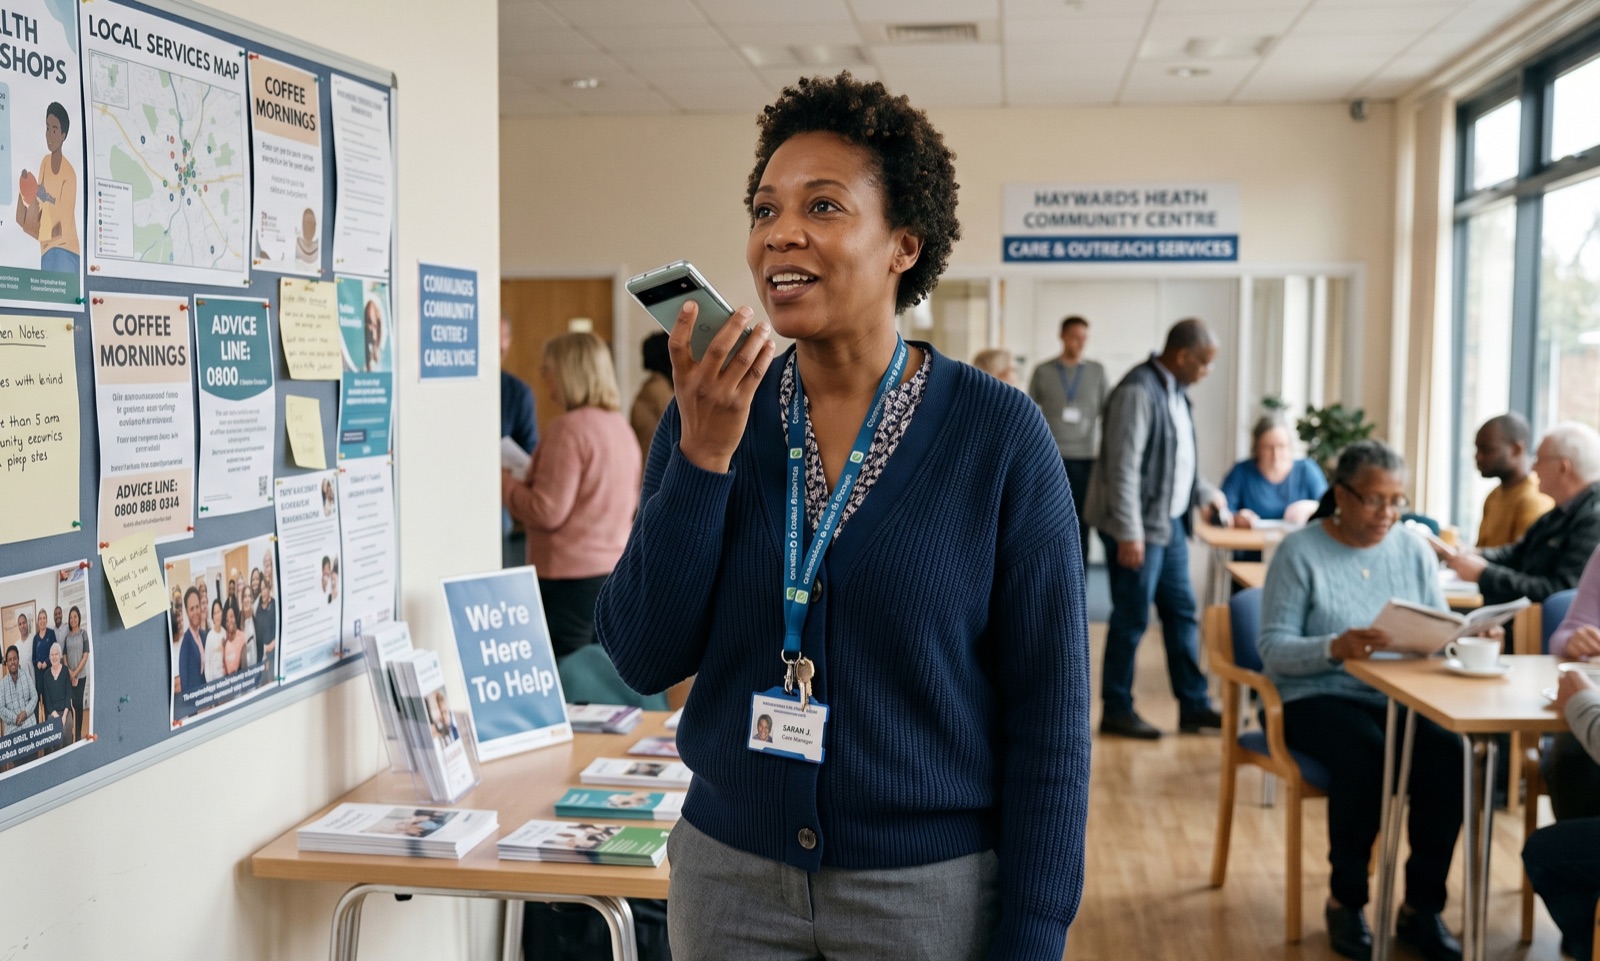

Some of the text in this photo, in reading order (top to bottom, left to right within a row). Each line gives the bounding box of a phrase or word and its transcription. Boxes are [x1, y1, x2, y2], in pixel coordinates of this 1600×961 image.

[0, 9, 38, 45] LTH
[88, 14, 240, 81] LOCAL SERVICES MAP
[0, 43, 67, 85] SHOPS
[265, 76, 306, 106] COFFEE
[256, 97, 316, 132] MORNINGS
[1034, 189, 1208, 207] HAYWARDS HEATH
[1022, 210, 1218, 228] COMMUNITY CENTRE
[1007, 239, 1235, 258] CARE & OUTREACH SERVICES
[112, 313, 171, 336] COFFEE
[211, 314, 257, 336] ADVICE
[100, 344, 187, 367] MORNINGS
[220, 340, 251, 361] LINE:
[15, 373, 35, 387] with
[206, 366, 239, 387] 0800
[9, 414, 31, 428] than
[35, 413, 41, 426] 5
[116, 478, 178, 500] ADVICE LINE:
[114, 501, 138, 518] 0800
[464, 601, 530, 633] We're
[479, 638, 533, 667] Here
[470, 665, 554, 704] To Help
[782, 724, 804, 735] SARAN
